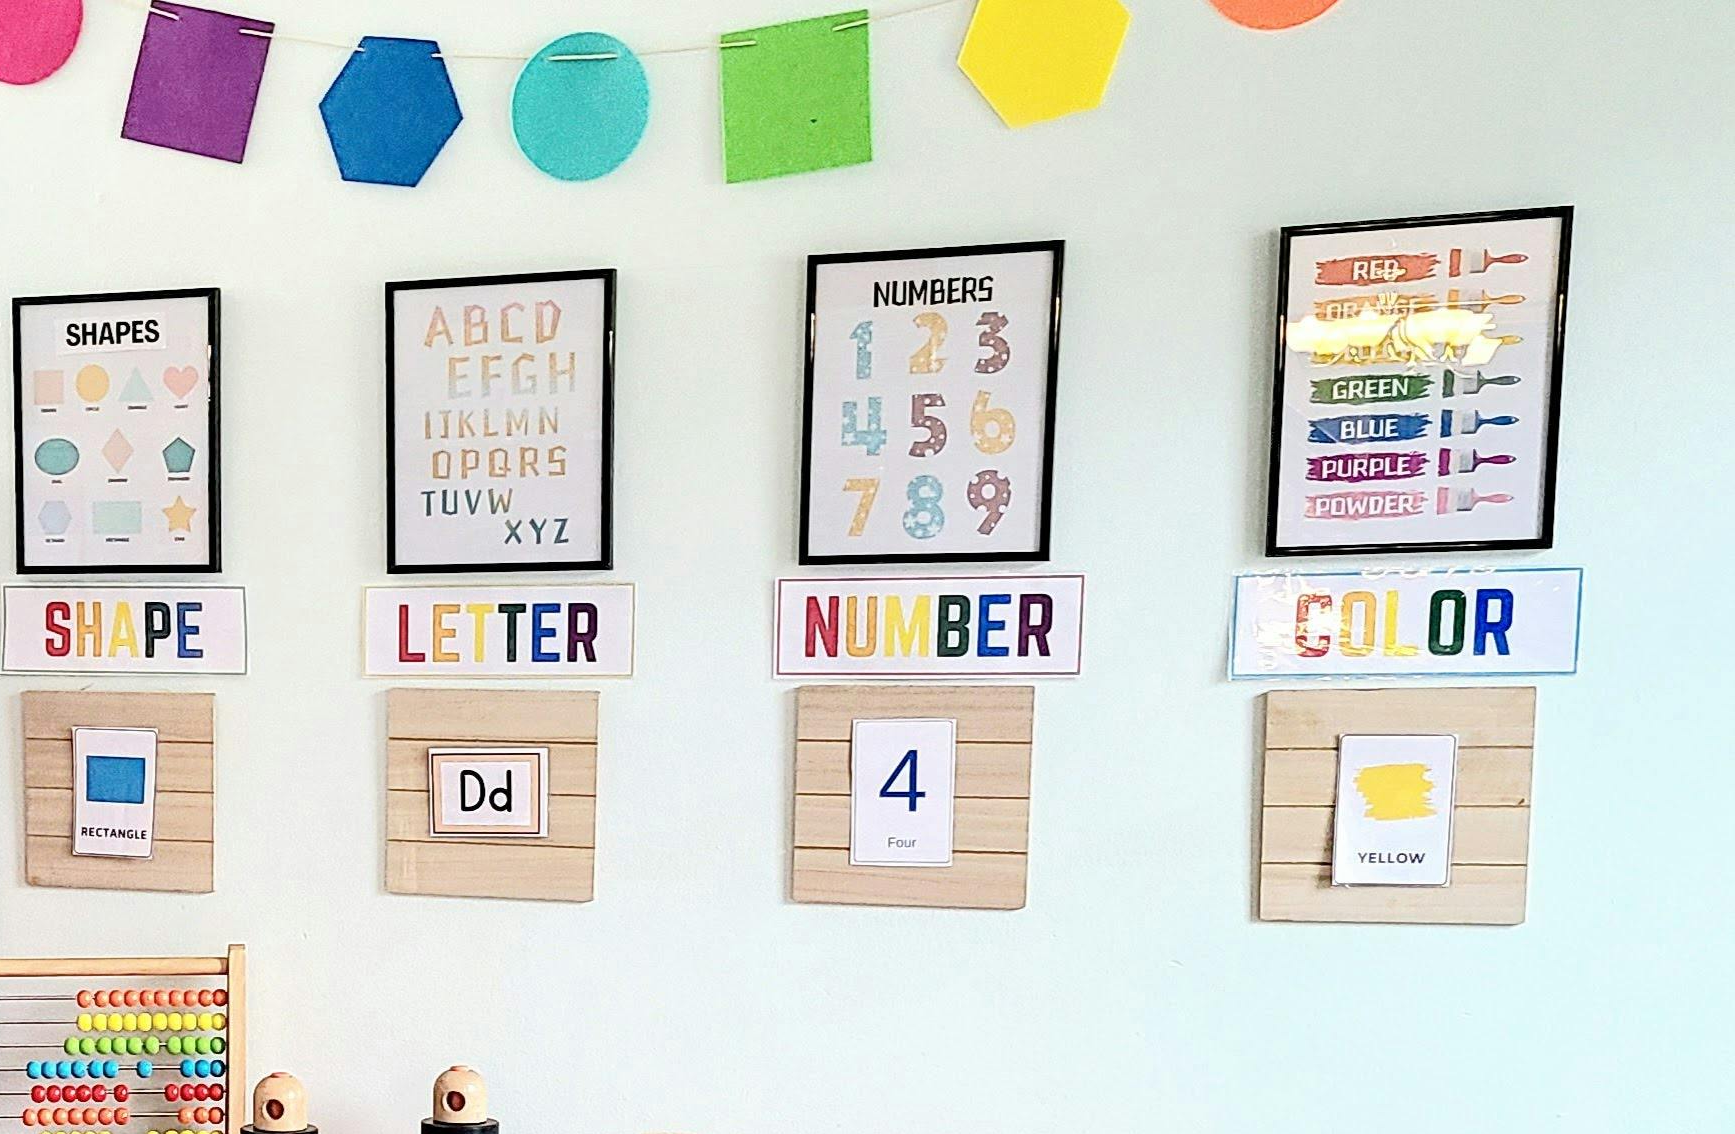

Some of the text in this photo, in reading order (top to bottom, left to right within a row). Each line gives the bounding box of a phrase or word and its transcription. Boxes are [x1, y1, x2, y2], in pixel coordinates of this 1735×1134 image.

[1352, 259, 1399, 281] RED
[872, 275, 994, 308] NUMBERS
[66, 319, 160, 347] SHAPES
[849, 311, 1011, 380] 1 2 3
[1332, 378, 1410, 400] GREEN
[841, 390, 1017, 458] 4 5 6
[1340, 417, 1399, 440] BLUE
[1321, 456, 1412, 480] PURPLE
[842, 469, 1012, 540] 7 8 9
[1315, 494, 1415, 516] POWDER
[45, 600, 204, 659] SHAPE
[398, 602, 598, 663] LETTER
[804, 593, 1053, 659] NUMBER
[1295, 588, 1514, 658] COLOR
[460, 769, 512, 812] Dd
[879, 749, 926, 812] 4
[81, 826, 147, 840] RECTANGLE
[887, 836, 917, 848] Four
[1358, 852, 1426, 864] YELLOW
